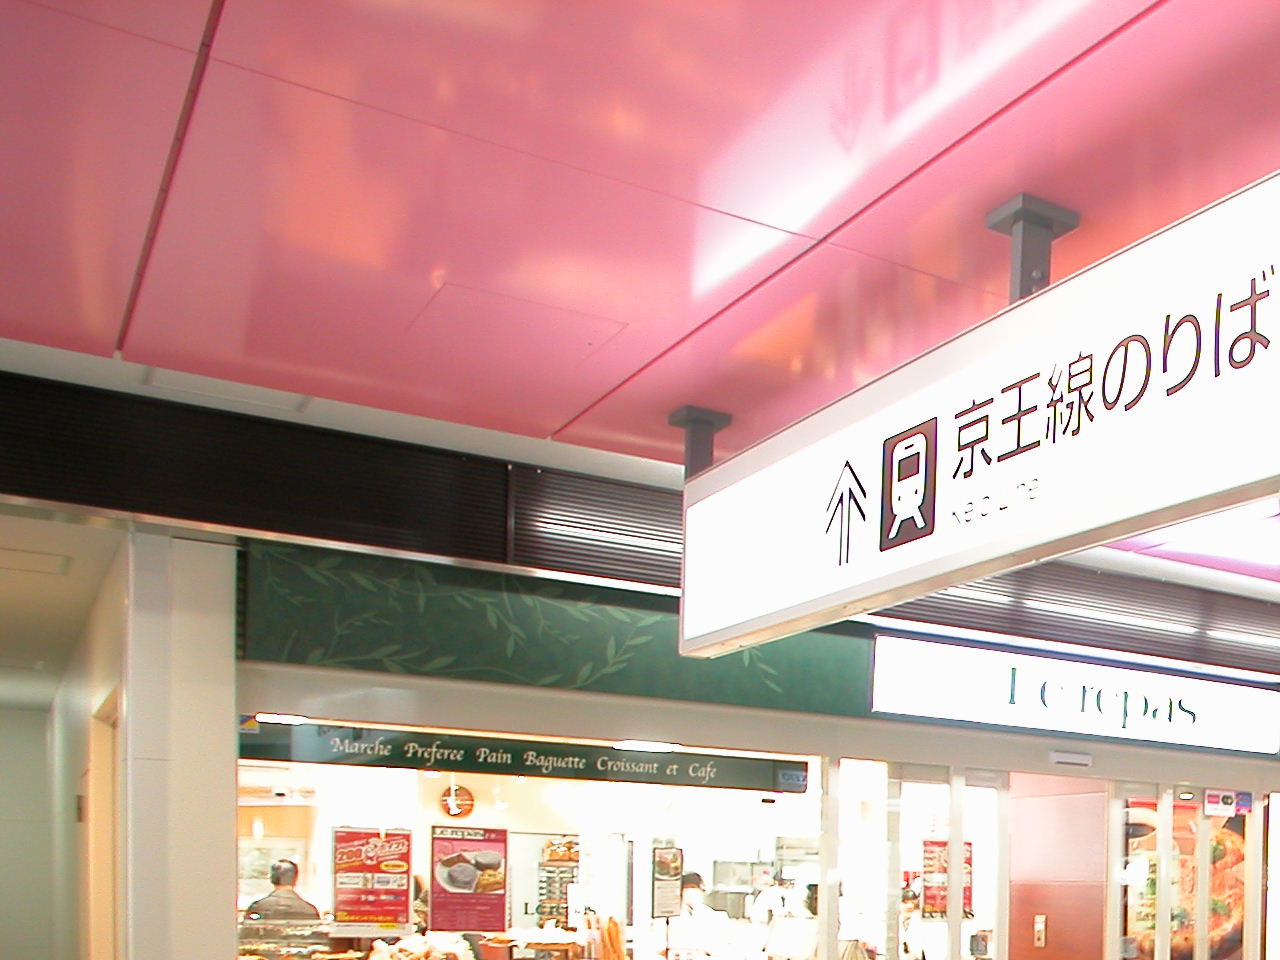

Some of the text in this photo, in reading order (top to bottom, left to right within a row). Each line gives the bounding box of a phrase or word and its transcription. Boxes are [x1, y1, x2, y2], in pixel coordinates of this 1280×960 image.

[953, 264, 1275, 480] 京王線のりば
[330, 736, 718, 784] Marche Preferee Pain Baguette Croissant et Cafe
